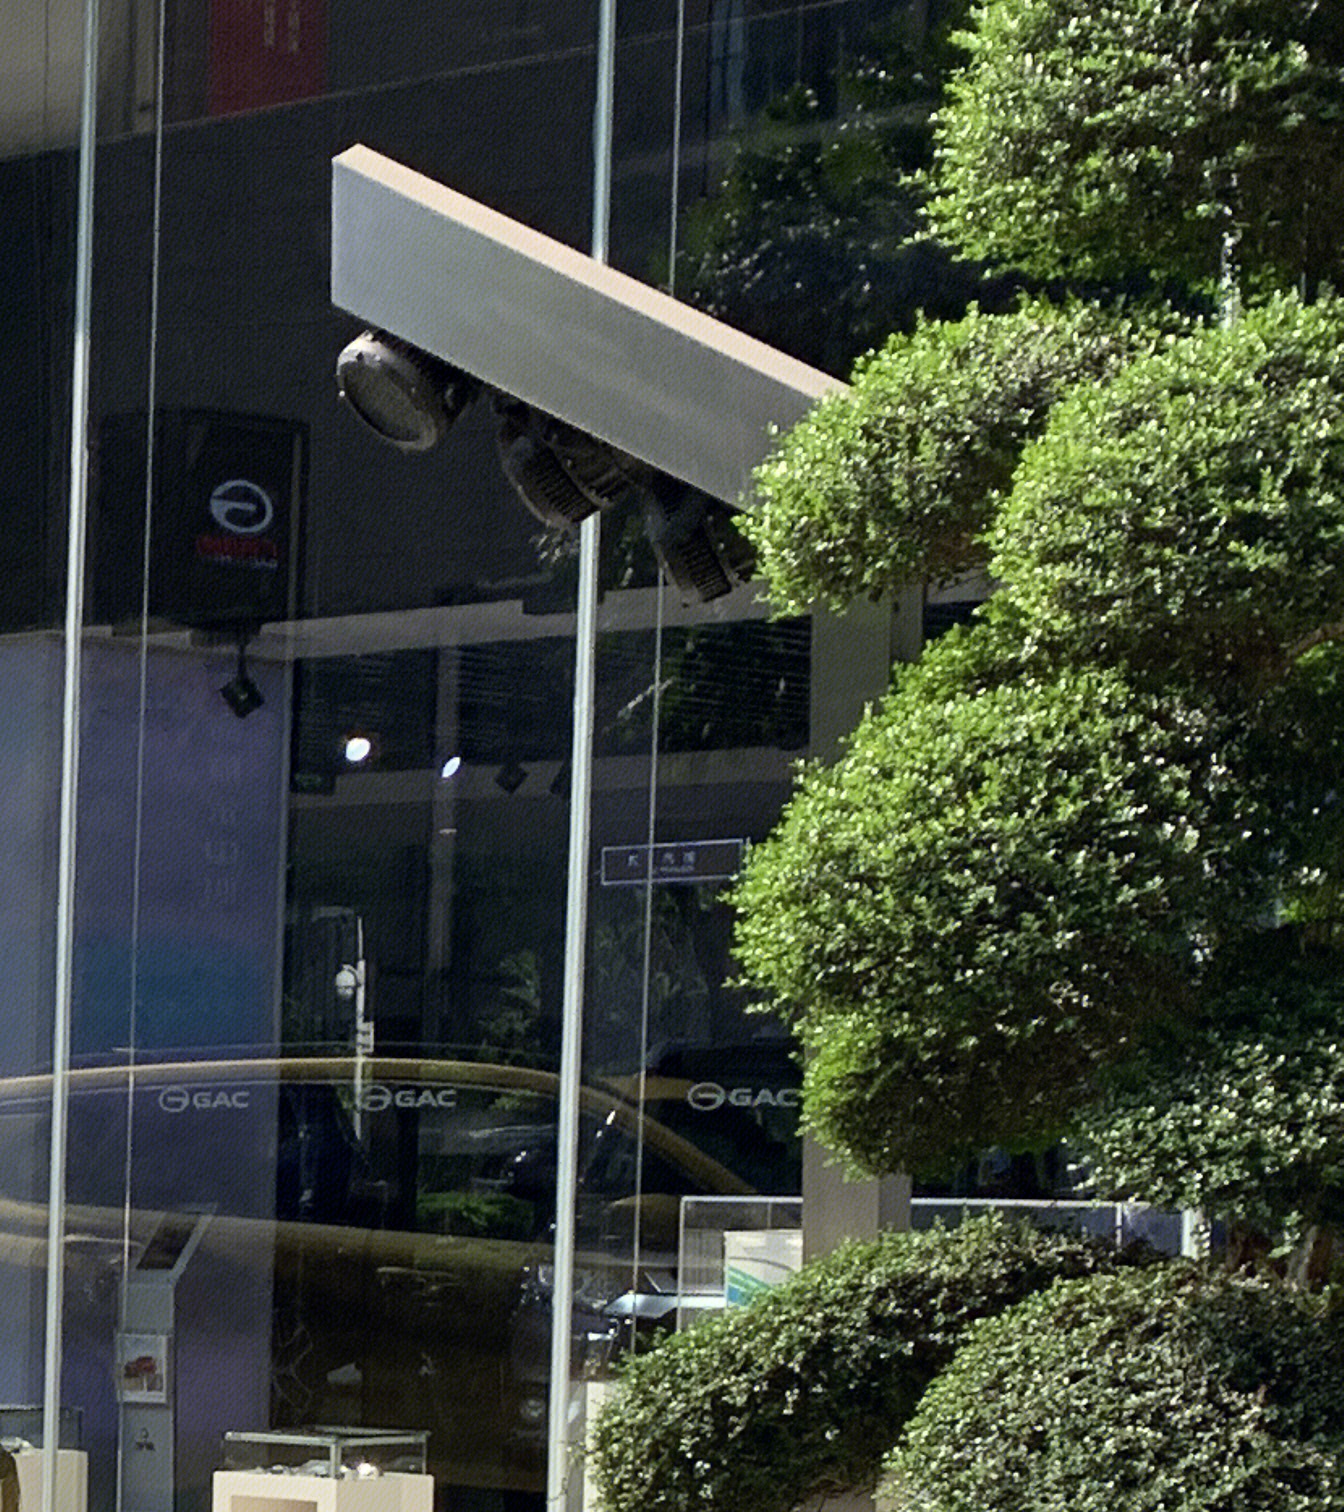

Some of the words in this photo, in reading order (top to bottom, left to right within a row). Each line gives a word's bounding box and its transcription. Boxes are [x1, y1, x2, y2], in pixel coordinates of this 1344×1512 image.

[192, 1091, 250, 1110] GAC
[394, 1089, 457, 1108] GAC
[728, 1087, 803, 1107] GAC
